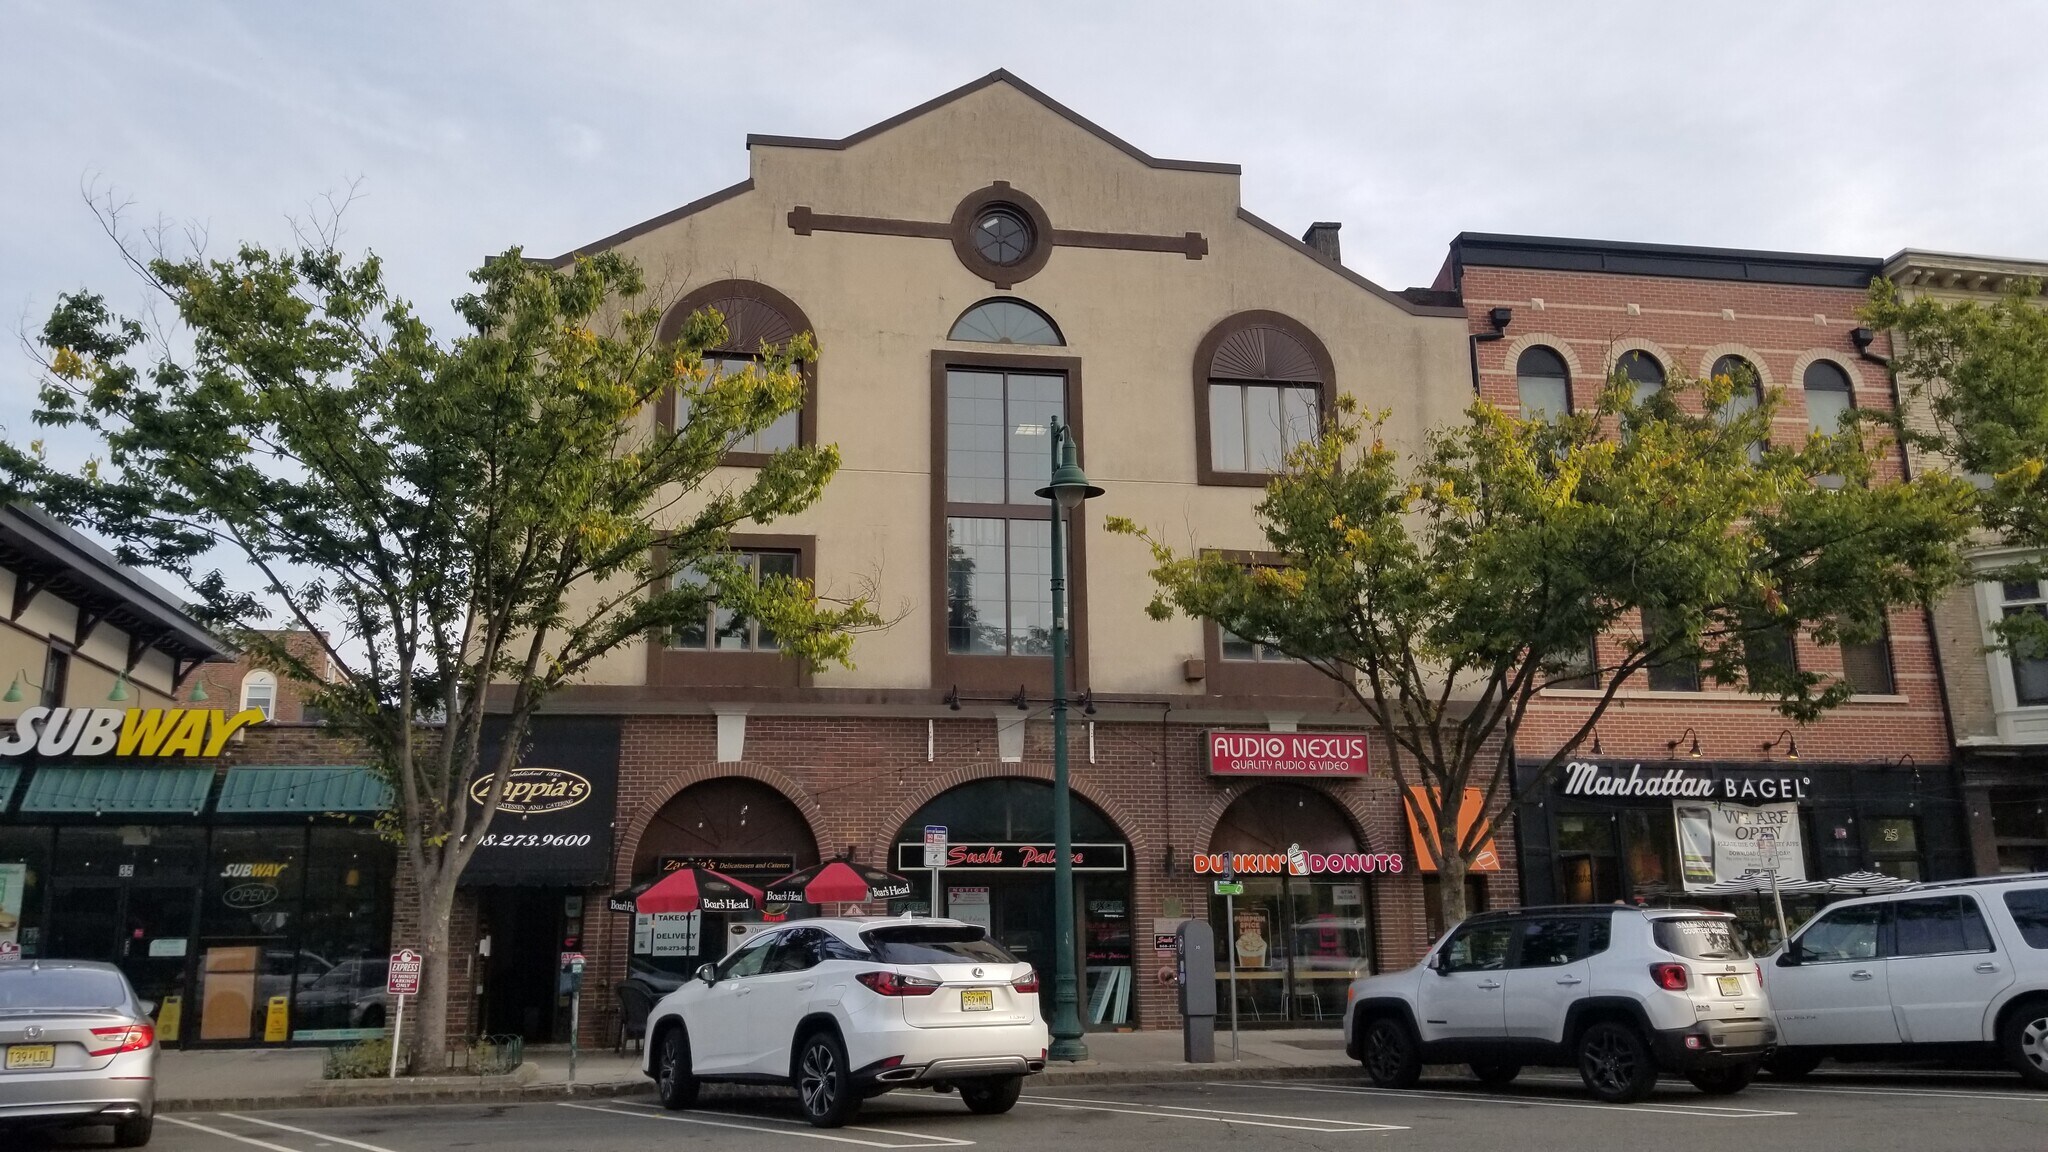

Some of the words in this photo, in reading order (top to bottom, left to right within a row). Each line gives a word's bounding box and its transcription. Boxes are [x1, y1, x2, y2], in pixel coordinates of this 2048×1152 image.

[0, 705, 270, 757] SUBWAY
[1214, 737, 1285, 758] AUDIO
[1293, 738, 1364, 759] NEXUS
[1231, 760, 1273, 770] QUALITY
[1274, 760, 1306, 770] AUDIO
[1309, 761, 1316, 769] &
[1317, 761, 1349, 771] VIDEO
[1566, 762, 1714, 796] Manhattan
[1725, 778, 1806, 798] BAGEL
[545, 799, 574, 810] CATERING
[1756, 810, 1789, 825] ARE
[1735, 826, 1782, 840] OPEN
[1883, 828, 1899, 842] 25
[460, 834, 591, 847] 8.273.9600
[947, 846, 1003, 866] Sushi
[1019, 846, 1084, 868] Pale
[1310, 853, 1403, 874] DONUTS
[119, 865, 134, 877] 35
[220, 863, 288, 877] SUBWAY
[719, 861, 755, 869] Delicatessen
[755, 861, 766, 869] and
[767, 861, 790, 869] Caterers
[229, 888, 271, 901] OPEN
[766, 890, 787, 901] Boar's
[873, 887, 889, 897] Boar's
[890, 884, 911, 896] Head
[704, 898, 725, 908] Boar's
[726, 899, 750, 909] Head
[658, 914, 698, 922] TAKEOT
[392, 963, 419, 972] EXPRESS
